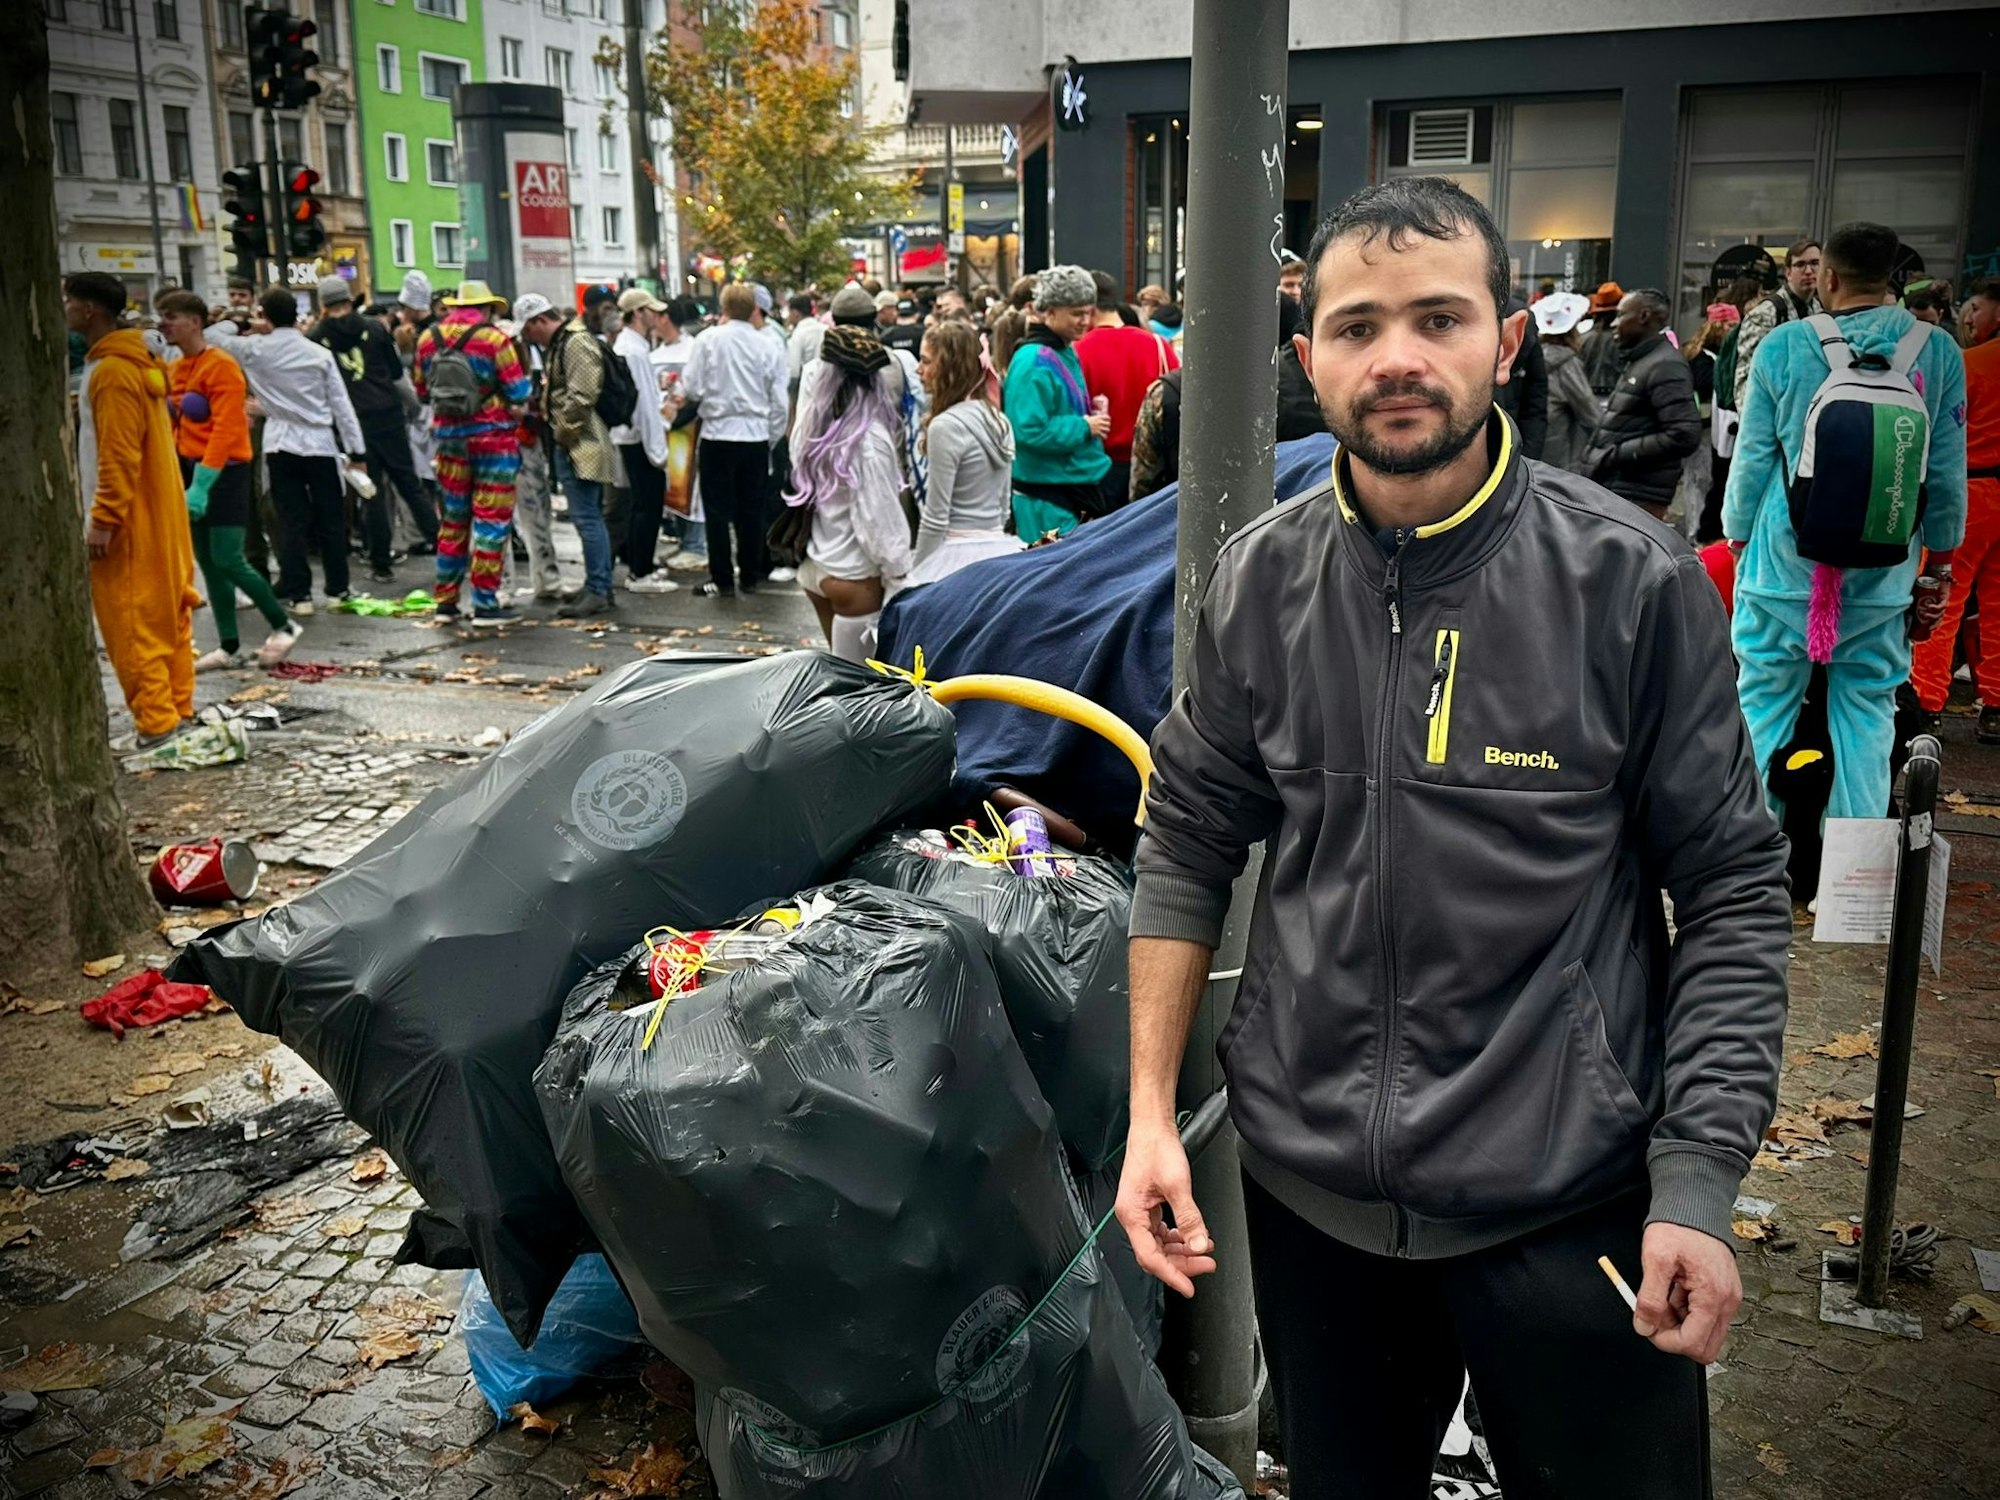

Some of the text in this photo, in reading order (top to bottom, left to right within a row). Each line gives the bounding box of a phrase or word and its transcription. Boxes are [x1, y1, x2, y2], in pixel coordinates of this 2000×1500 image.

[1886, 416, 1916, 534] Champion
[1388, 601, 1400, 633] Bench.
[1425, 681, 1440, 715] Bench.
[1484, 746, 1560, 770] Bench.
[623, 753, 684, 807] BLAUER ENGEL
[942, 1305, 981, 1354] BLAUER
